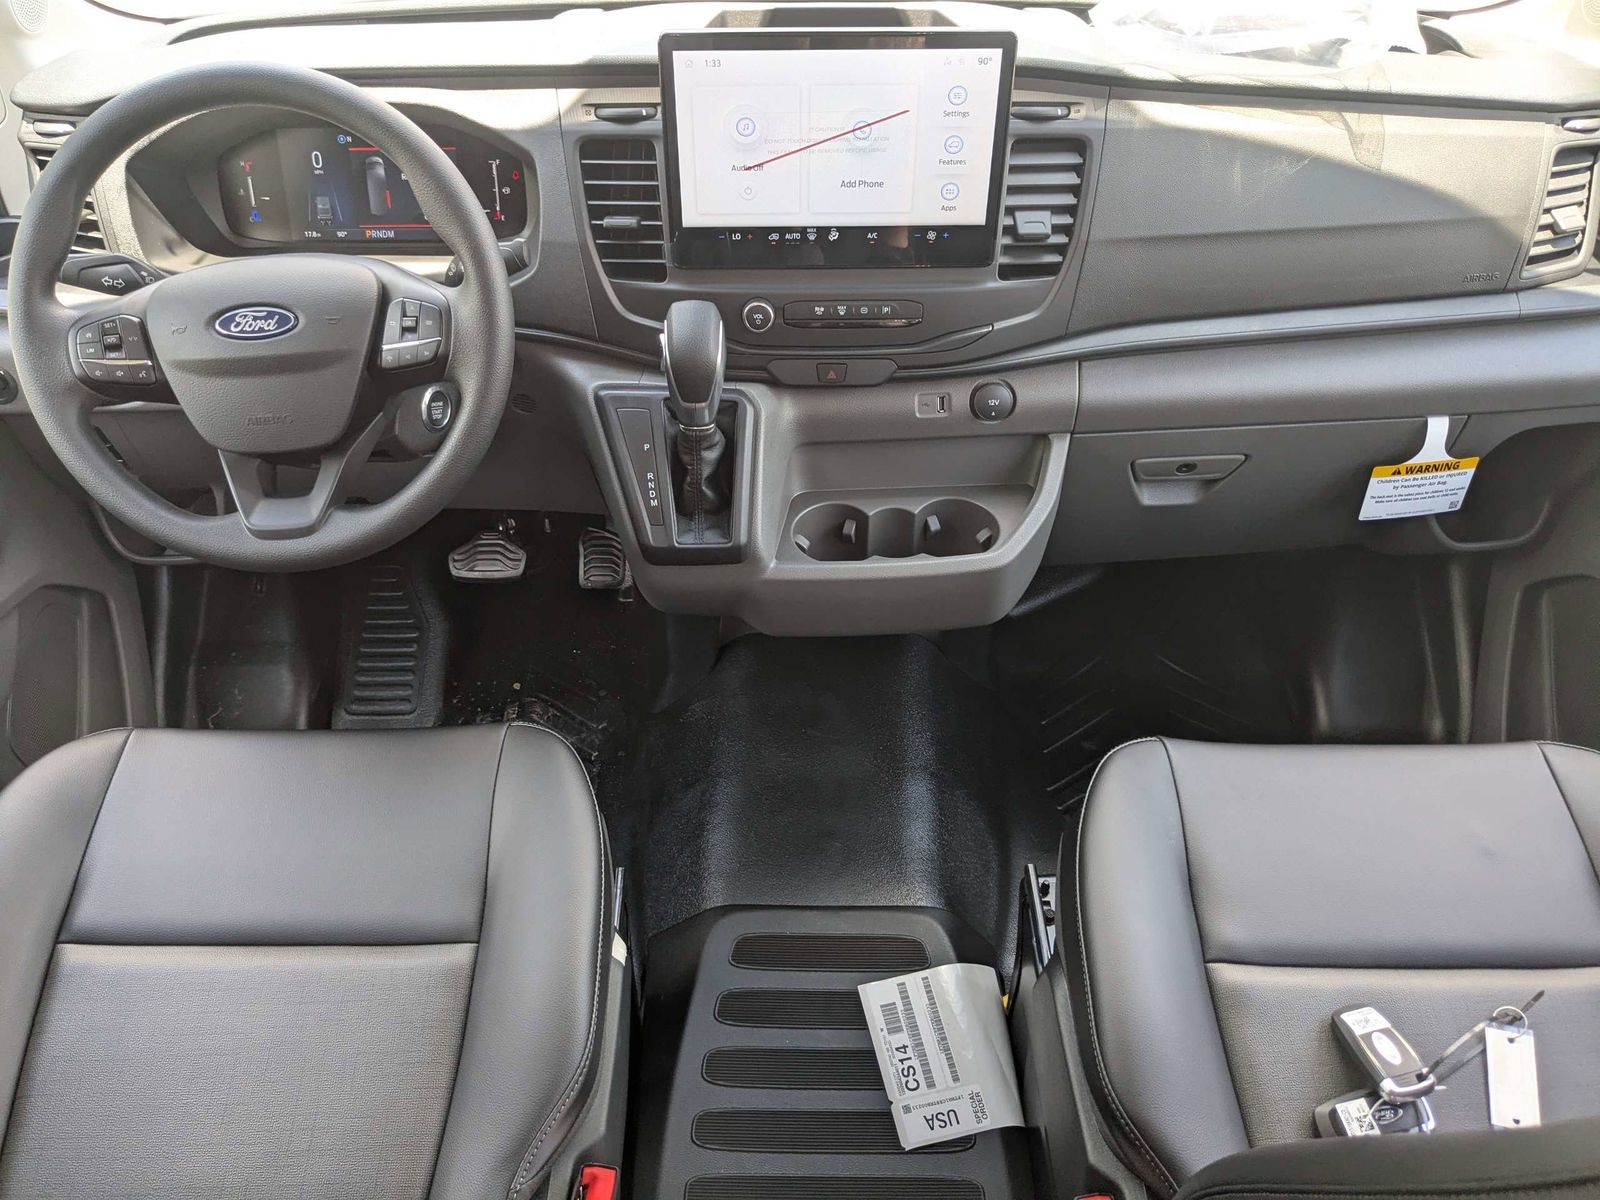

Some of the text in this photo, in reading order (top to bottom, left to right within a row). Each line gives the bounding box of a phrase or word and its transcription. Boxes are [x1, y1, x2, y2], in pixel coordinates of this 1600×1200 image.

[704, 58, 721, 68] 1:33
[943, 110, 970, 118] Settings
[311, 150, 323, 169] 0
[938, 158, 967, 166] Features
[840, 179, 884, 188] Add Phone
[941, 204, 957, 212] Apps
[1462, 271, 1500, 284] AIRBAG
[230, 311, 279, 333] Ford
[247, 414, 294, 426] AIRBAG
[644, 443, 650, 451] P
[1405, 460, 1461, 475] WARNING
[647, 472, 654, 480] R
[648, 481, 655, 489] N
[895, 1043, 920, 1092] CS14
[968, 1090, 982, 1125] SPECIAL
[975, 1091, 989, 1120] ORDER
[923, 1109, 960, 1131] USA
